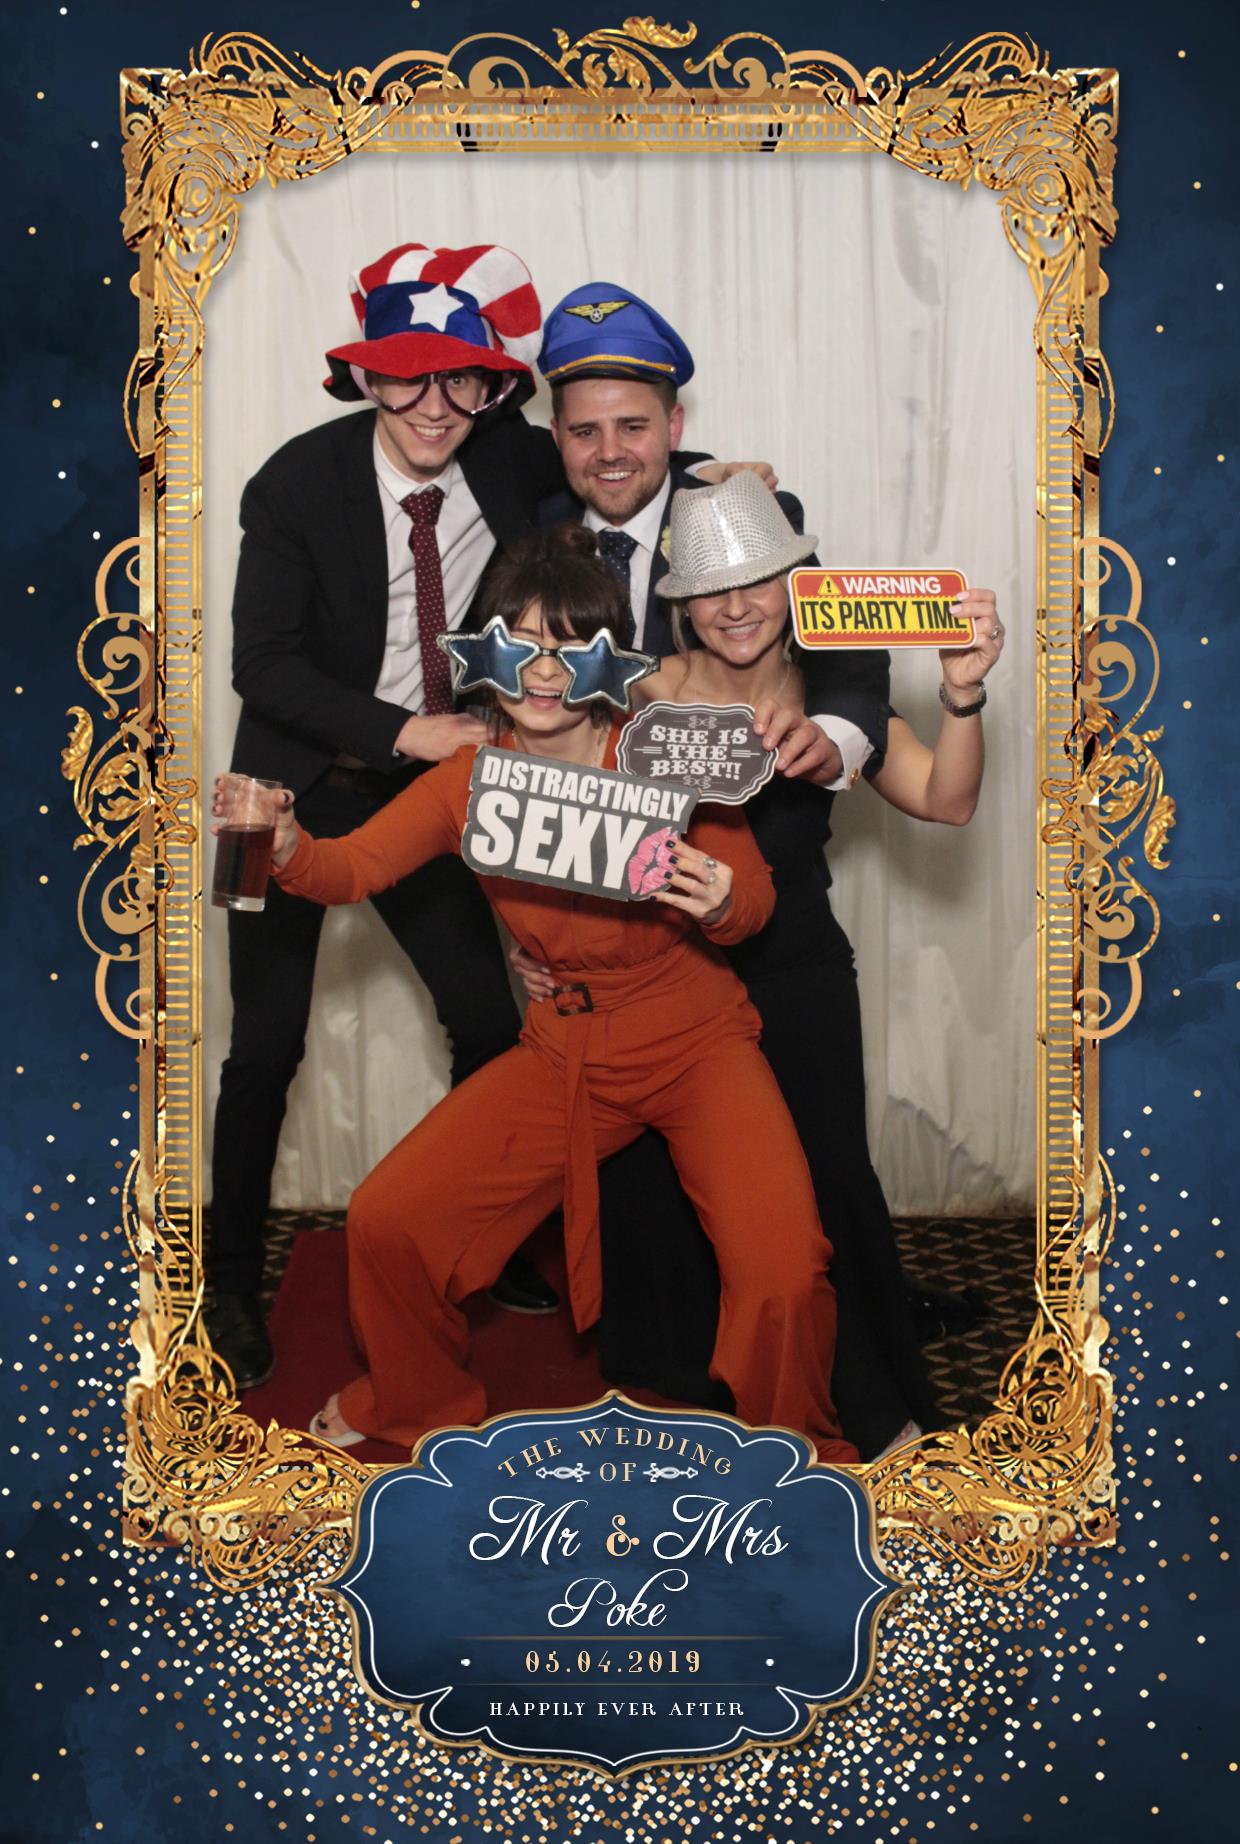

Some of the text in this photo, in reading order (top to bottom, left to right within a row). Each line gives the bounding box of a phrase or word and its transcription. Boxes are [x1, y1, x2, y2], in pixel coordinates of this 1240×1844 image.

[842, 576, 942, 595] WARNING
[801, 601, 834, 631] ITS
[842, 600, 907, 631] PARTY
[649, 725, 750, 746] SHE IS
[666, 744, 728, 761] THE
[650, 760, 742, 781] BEST!!
[481, 755, 690, 823] DISTRACTINGLY
[470, 790, 647, 890] SEXY
